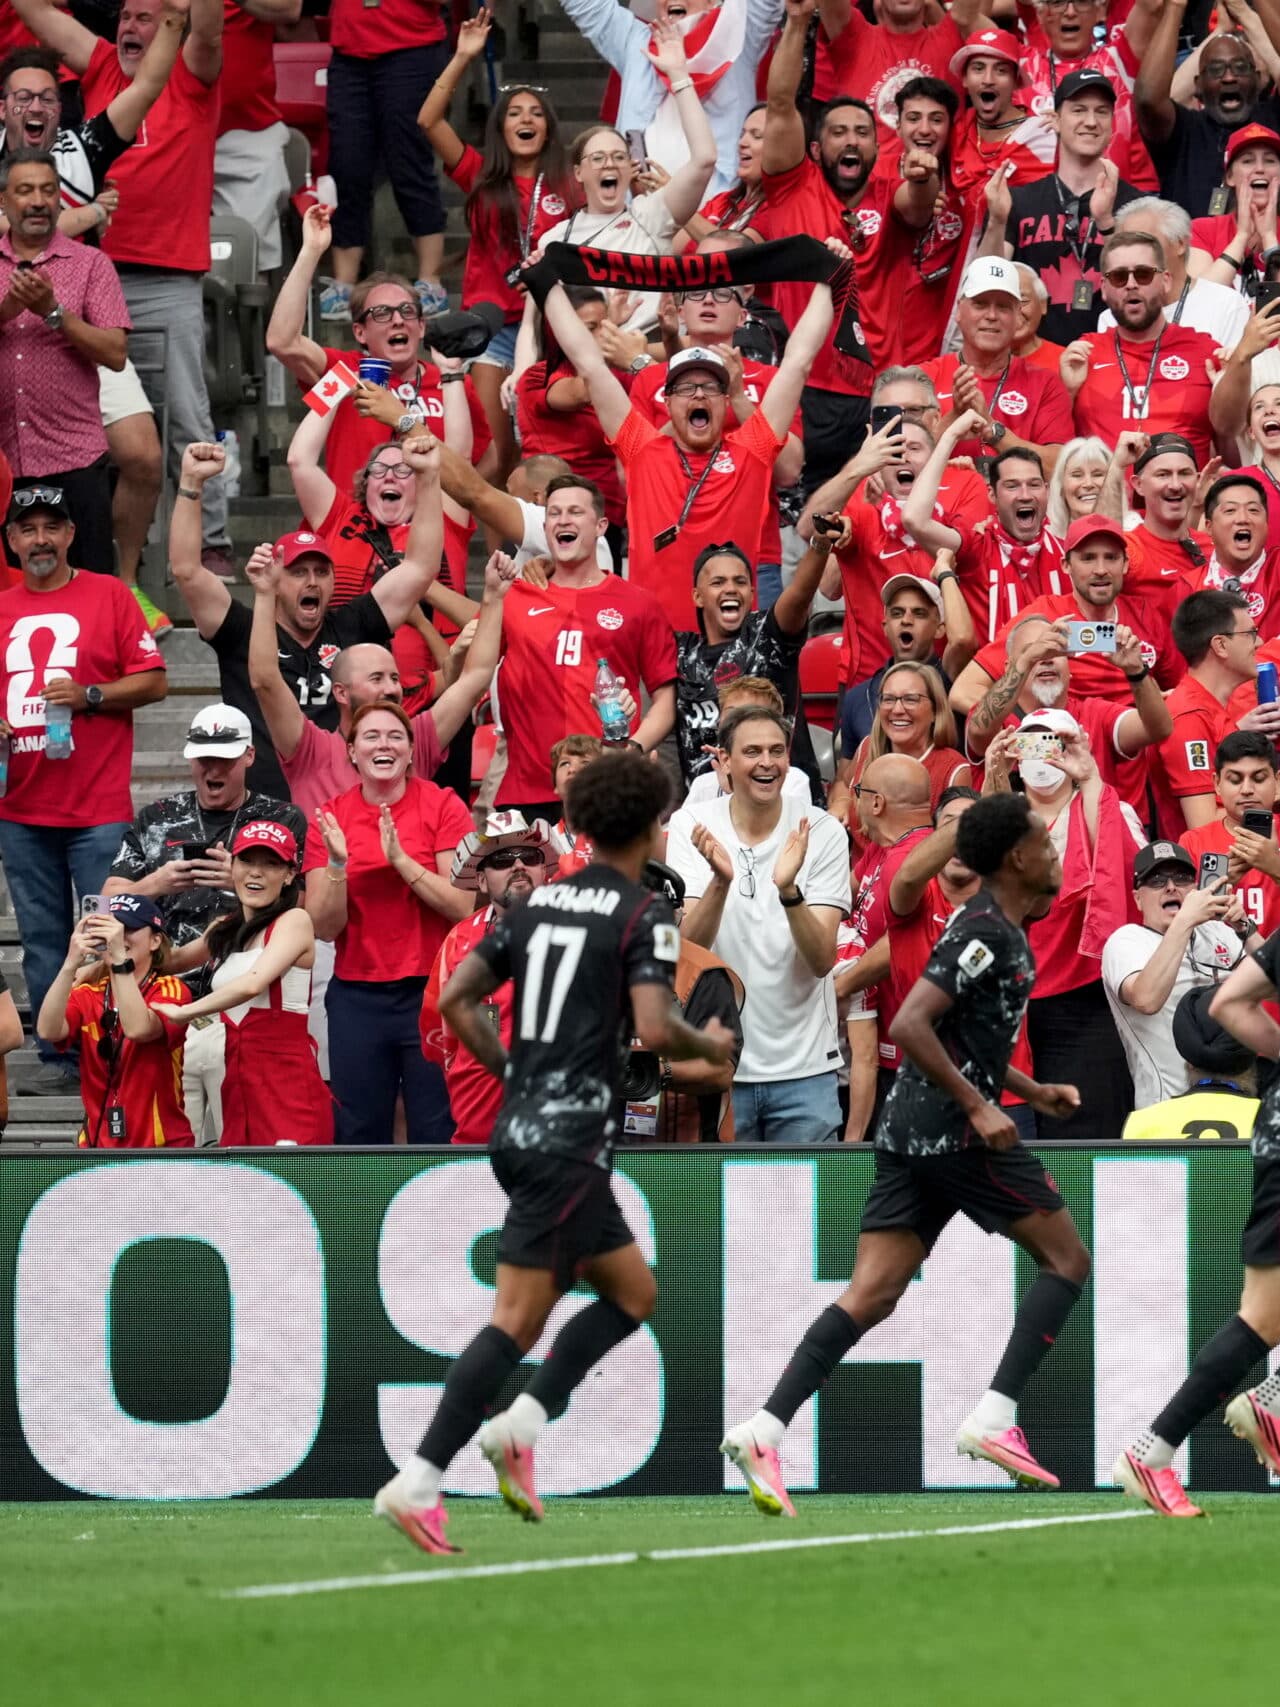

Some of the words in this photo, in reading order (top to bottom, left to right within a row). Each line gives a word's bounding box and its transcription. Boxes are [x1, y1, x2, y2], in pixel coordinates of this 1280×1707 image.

[582, 245, 732, 286] CANADA
[1121, 385, 1150, 420] 19
[555, 629, 583, 666] 19
[685, 700, 720, 729] 19
[12, 735, 75, 754] CANA
[243, 823, 288, 844] CANADA
[1235, 887, 1265, 925] 19
[520, 922, 588, 1043] 17
